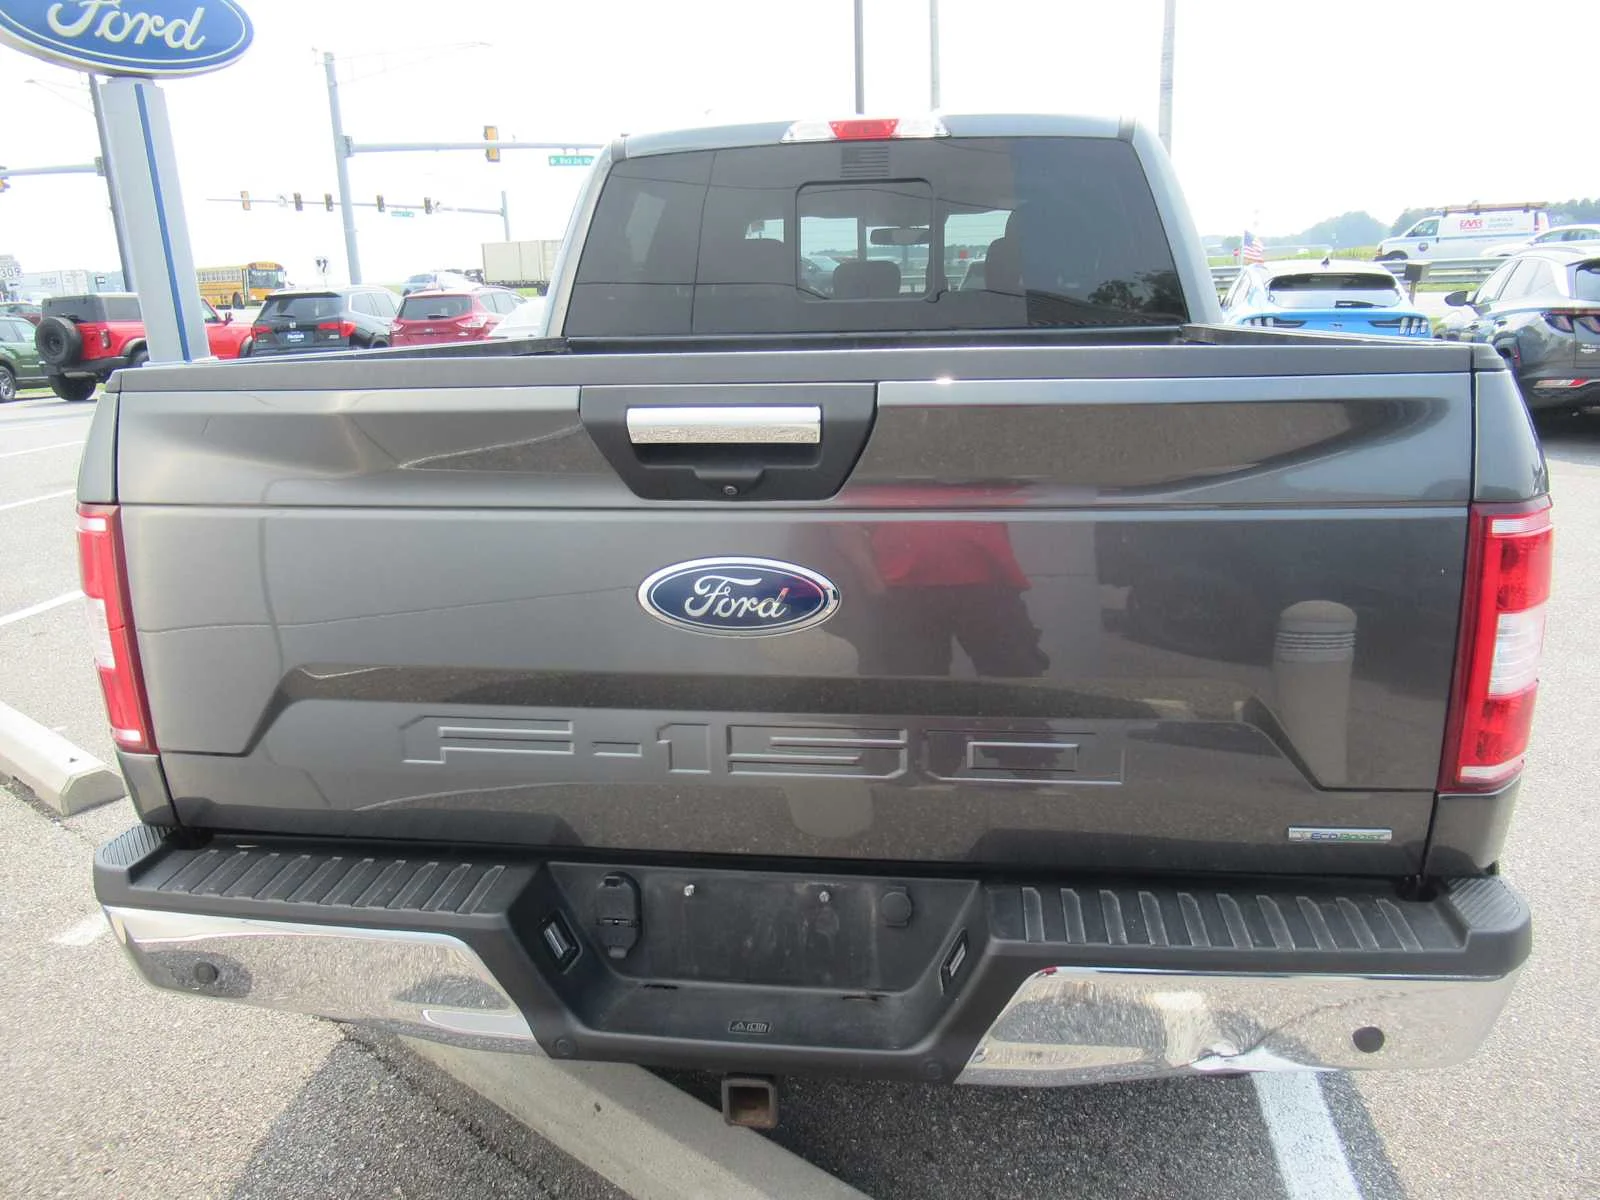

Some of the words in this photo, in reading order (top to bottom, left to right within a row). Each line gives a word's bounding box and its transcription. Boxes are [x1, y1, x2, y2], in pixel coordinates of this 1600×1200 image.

[47, 0, 206, 51] Ford
[684, 575, 789, 618] Ford
[402, 714, 1126, 786] F-150
